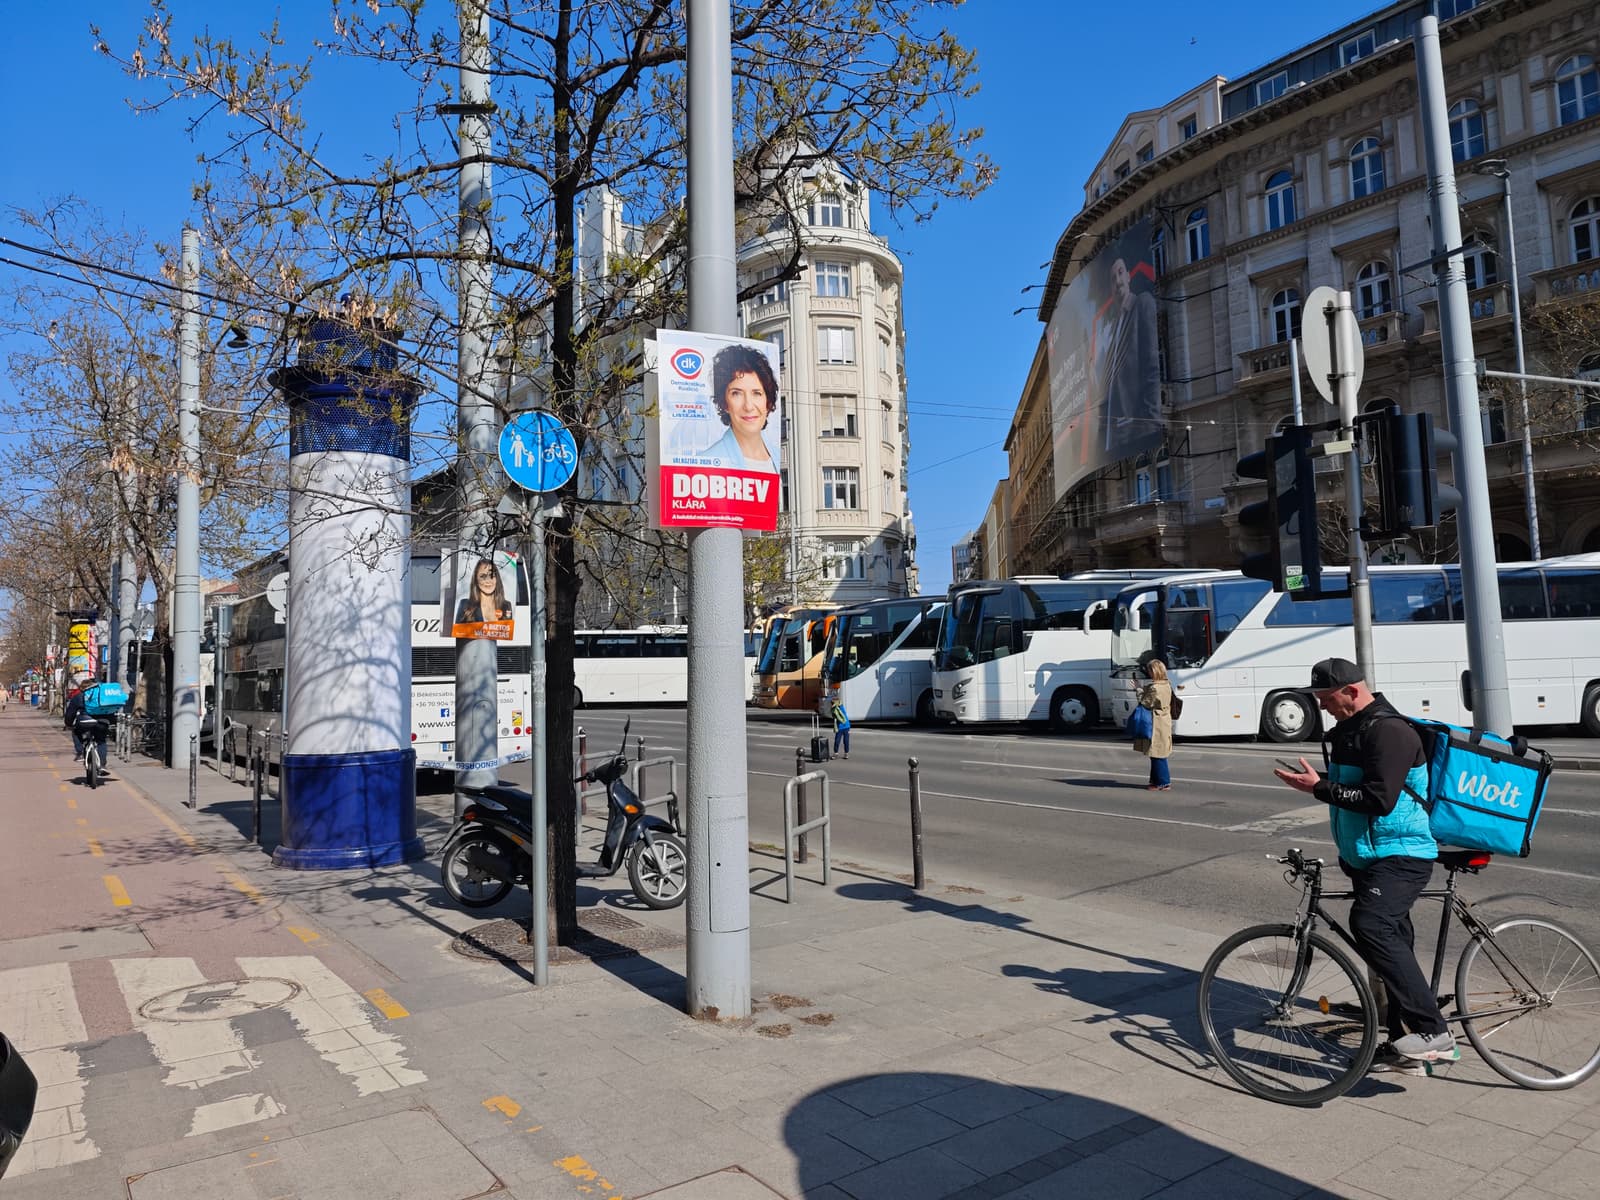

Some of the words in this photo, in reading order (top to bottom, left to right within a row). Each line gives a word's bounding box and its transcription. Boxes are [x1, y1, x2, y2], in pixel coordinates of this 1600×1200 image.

[680, 358, 697, 370] dk
[672, 473, 770, 503] DOBREV
[672, 499, 706, 510] KLÁRA
[418, 720, 456, 728] www.vo
[1457, 770, 1523, 809] Wolt
